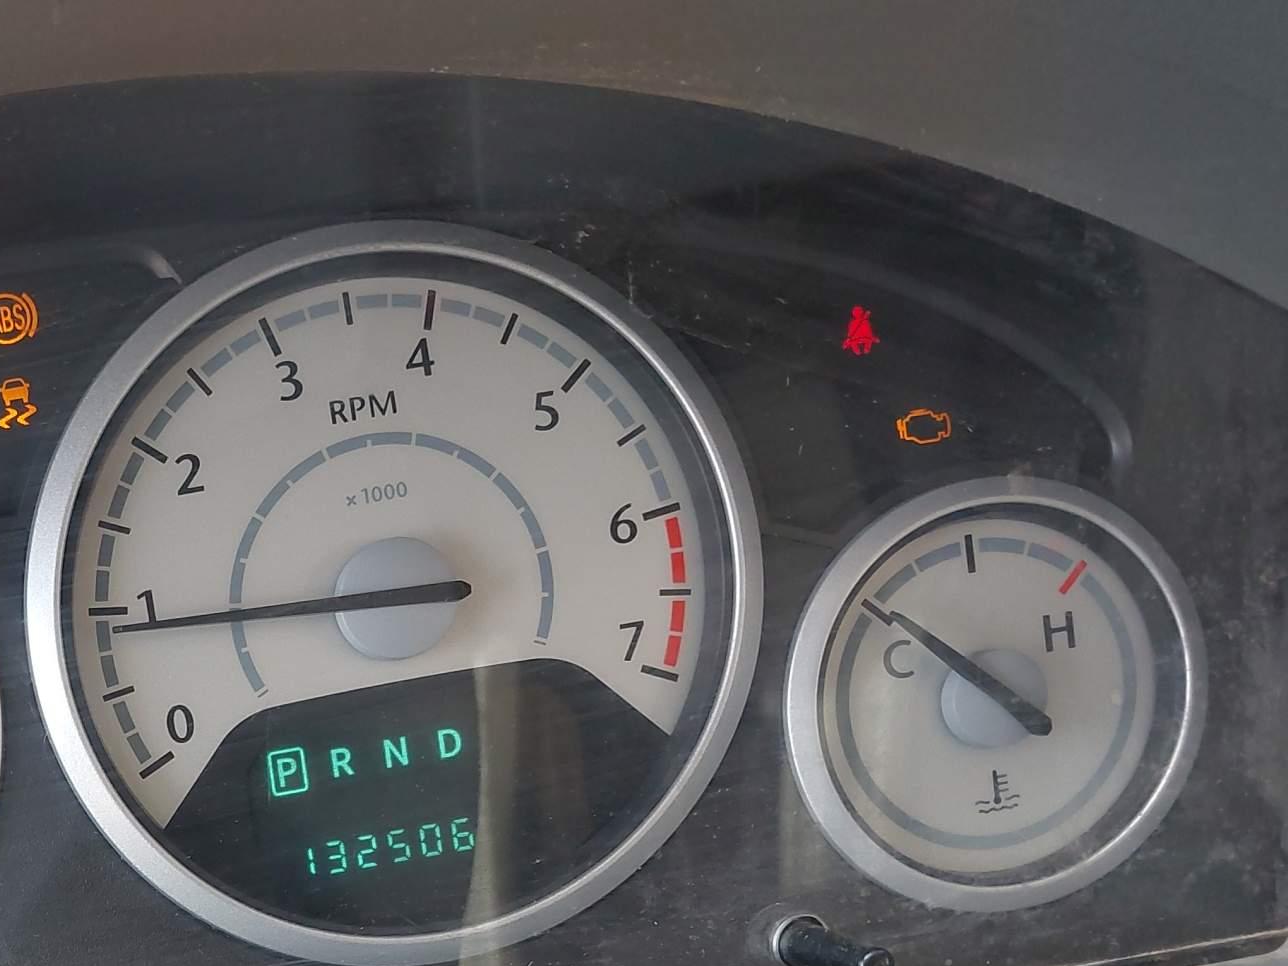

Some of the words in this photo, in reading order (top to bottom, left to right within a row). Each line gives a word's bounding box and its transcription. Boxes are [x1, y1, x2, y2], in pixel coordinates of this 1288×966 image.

[405, 337, 435, 376] 4
[275, 360, 304, 401] 3
[329, 390, 398, 425] RPM
[535, 390, 560, 431] 5
[175, 453, 205, 495] 2
[610, 503, 638, 544] 6
[136, 589, 157, 625] 1
[619, 620, 644, 661] 7
[1042, 611, 1075, 652] H
[883, 639, 915, 679] C
[166, 704, 195, 743] 0
[276, 758, 297, 788] P
[330, 747, 355, 778] R
[383, 736, 409, 768] N
[437, 728, 462, 759] D
[307, 818, 475, 875] 132506
